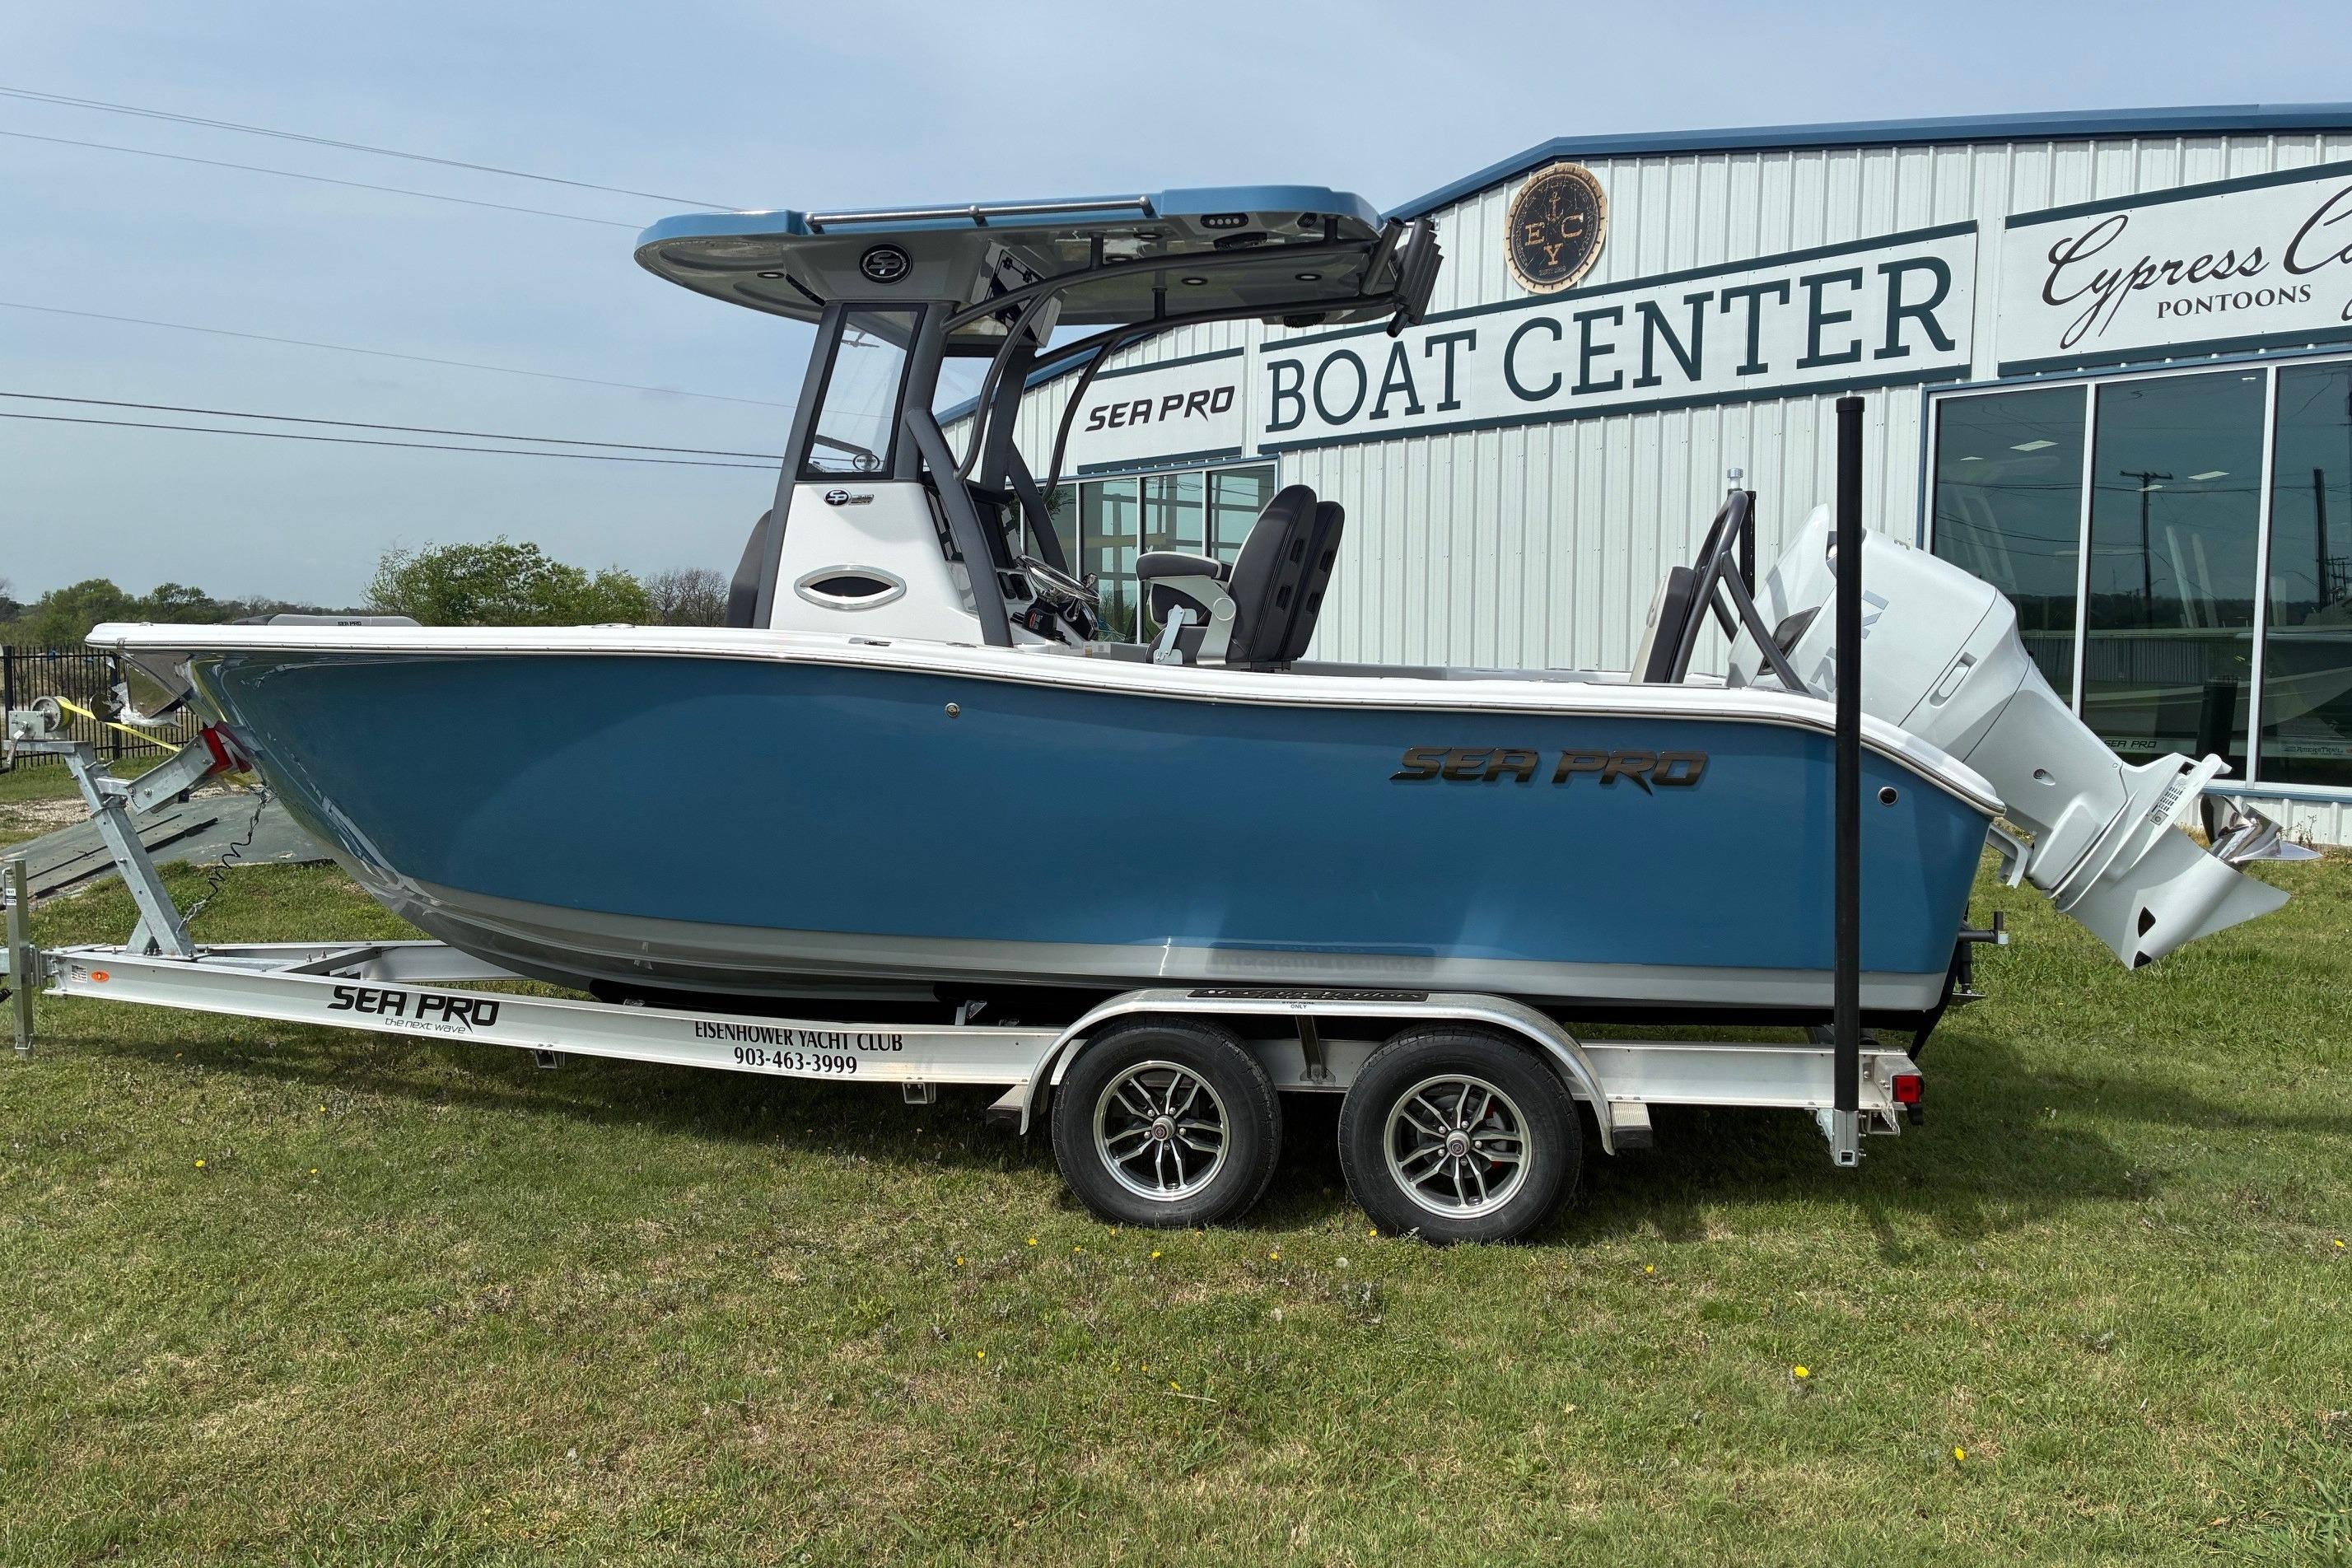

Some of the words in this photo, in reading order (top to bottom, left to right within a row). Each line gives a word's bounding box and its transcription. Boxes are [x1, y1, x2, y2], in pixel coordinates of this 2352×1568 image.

[2042, 214, 2270, 350] Cypress
[2157, 284, 2312, 320] PONTOONS
[1265, 329, 1477, 434] BOAT
[1503, 256, 1956, 402] CENTER
[1084, 399, 1153, 432] SEA
[1158, 385, 1235, 422] PRO
[2104, 740, 2127, 748] SEA
[2130, 740, 2157, 749] PRO
[1388, 747, 1539, 782] SEA
[1551, 749, 1709, 797] PRO
[327, 985, 408, 1017] SEA
[415, 993, 500, 1034] PRO
[385, 1017, 404, 1027] the
[404, 1019, 433, 1031] next
[434, 1023, 467, 1035] wave
[695, 1020, 794, 1046] EISENHOWER
[798, 1030, 850, 1050] YACHT
[856, 1033, 903, 1052] CLUB
[734, 1046, 858, 1075] 903-463-3999
